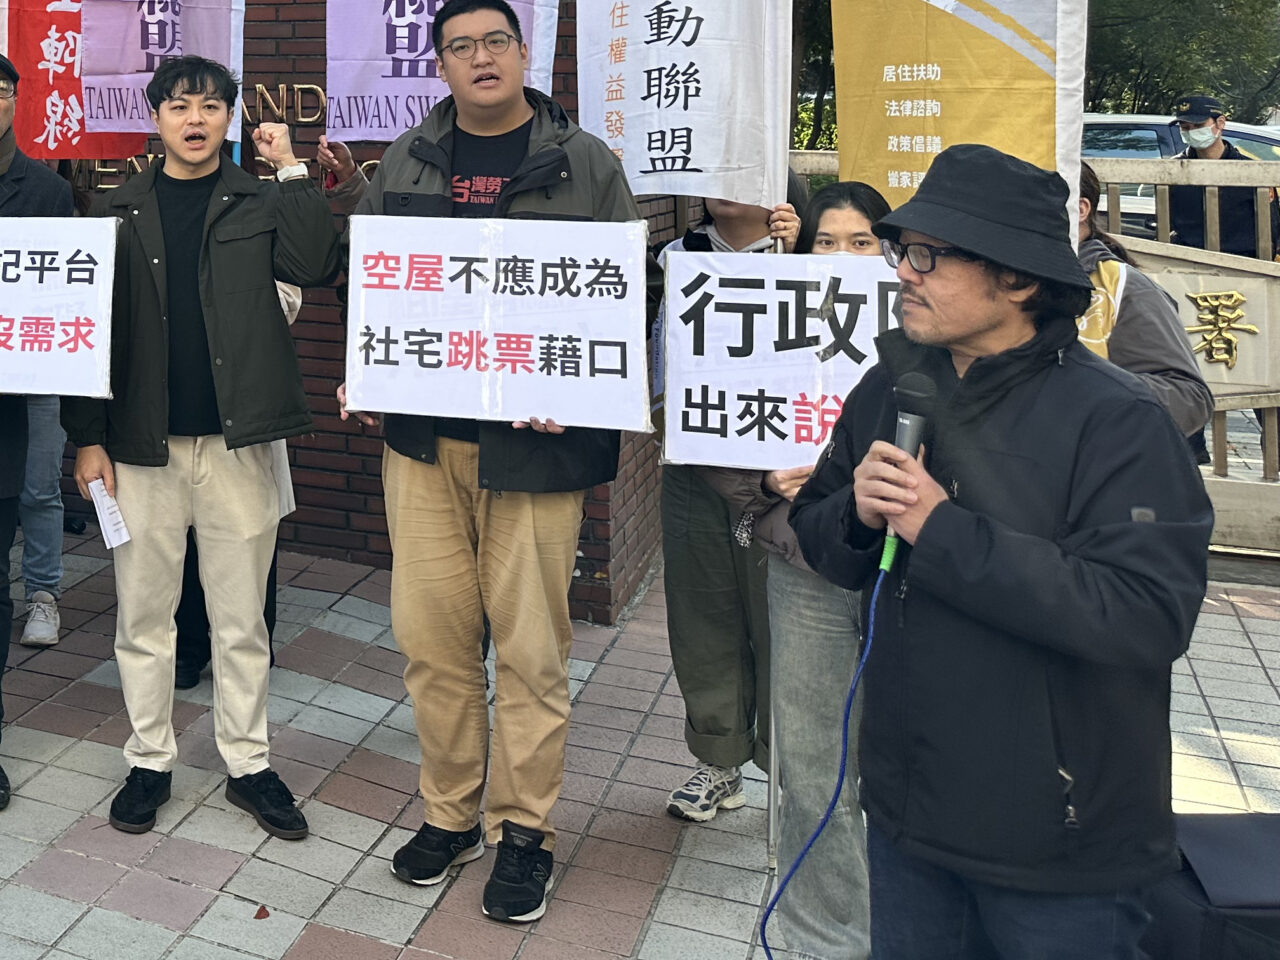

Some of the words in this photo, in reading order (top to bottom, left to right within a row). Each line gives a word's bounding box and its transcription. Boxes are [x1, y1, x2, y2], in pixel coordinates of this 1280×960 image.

[883, 63, 942, 82] 居住扶助
[85, 86, 152, 120] TAIWAN
[326, 95, 399, 129] TAIWAN
[405, 95, 450, 129] SW
[884, 99, 942, 117] 法律諮詢
[887, 135, 943, 153] 政策倡議
[451, 175, 511, 203] 台灣勞
[360, 250, 629, 301] 空屋不應成為
[679, 271, 903, 365] 行政
[1185, 290, 1260, 369] 署
[357, 324, 629, 380] 社宅跳票藉口
